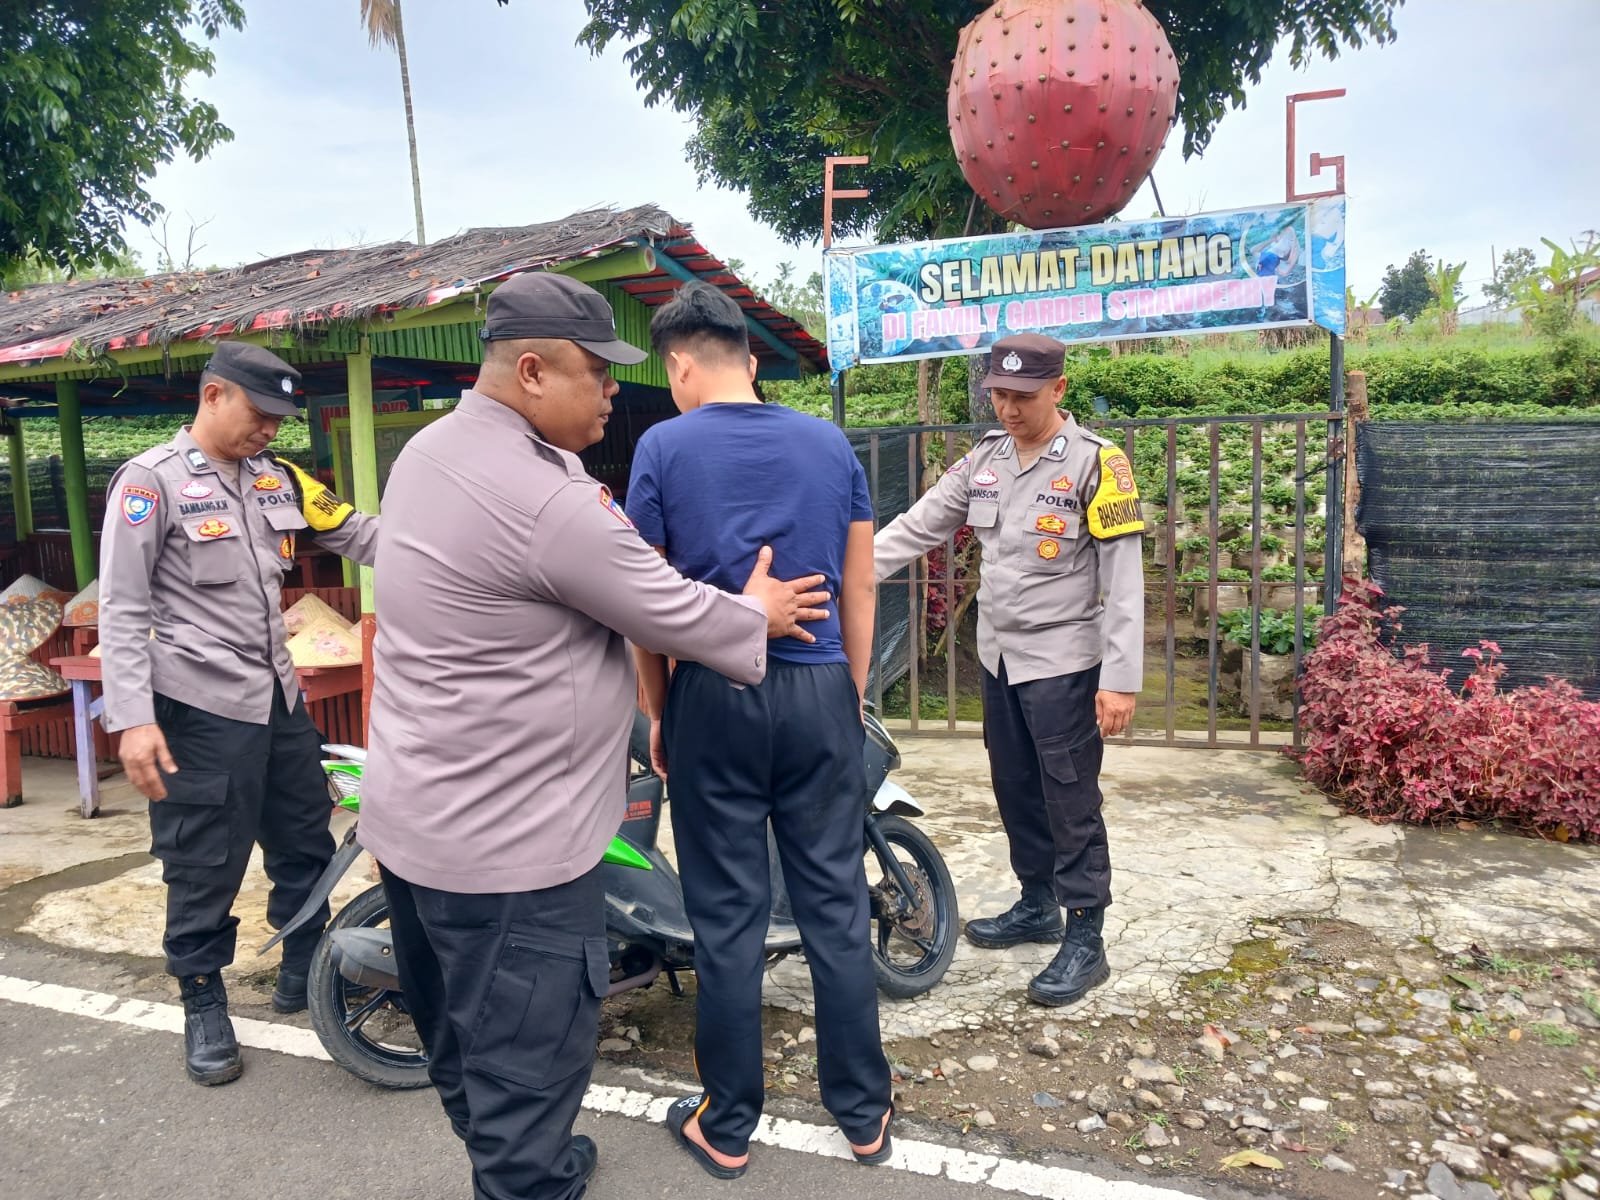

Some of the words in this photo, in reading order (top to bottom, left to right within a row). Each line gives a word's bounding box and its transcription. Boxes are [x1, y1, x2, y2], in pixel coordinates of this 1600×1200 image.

[919, 247, 1080, 303] SELAMAT
[1090, 232, 1233, 287] DATANG
[882, 312, 907, 341] DI
[911, 303, 1000, 340] FAMILY
[1006, 294, 1103, 330] GARDEN
[1107, 276, 1278, 321] STRAWBERRY
[257, 492, 295, 507] POLRI
[1036, 493, 1077, 510] POLRI
